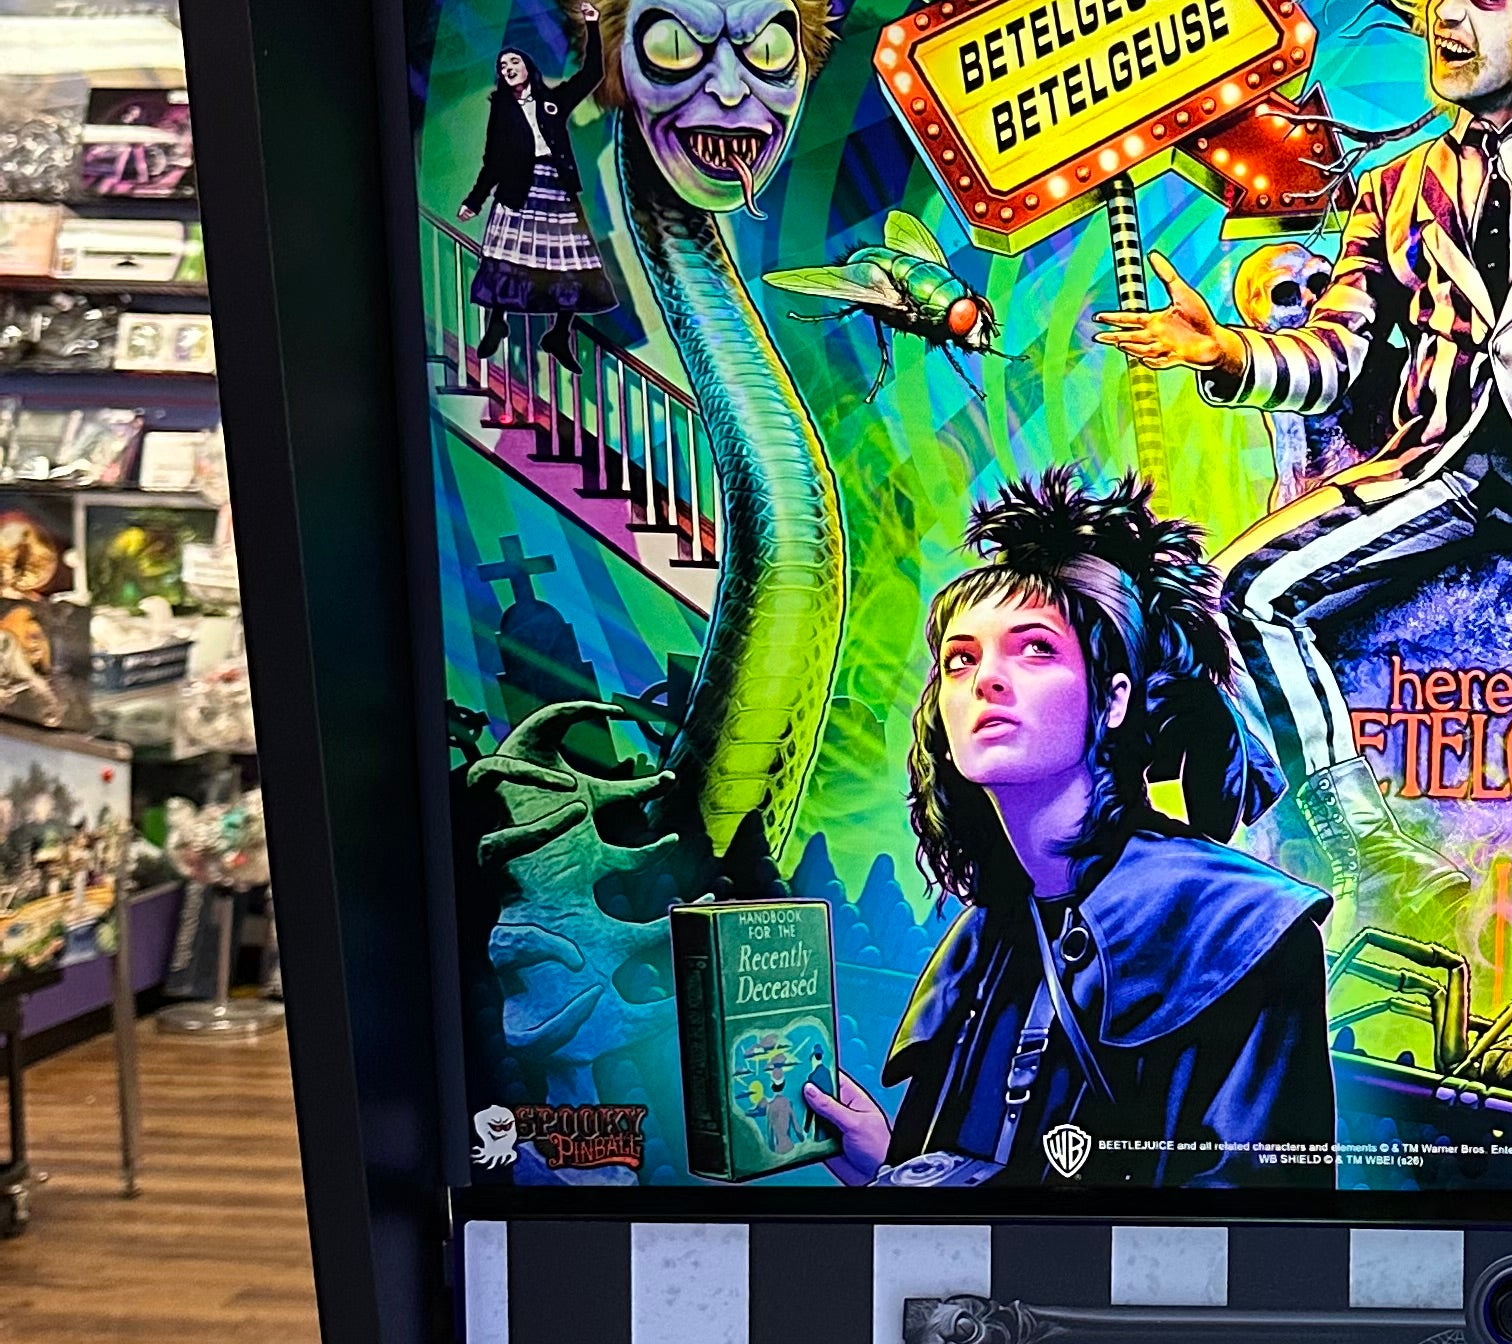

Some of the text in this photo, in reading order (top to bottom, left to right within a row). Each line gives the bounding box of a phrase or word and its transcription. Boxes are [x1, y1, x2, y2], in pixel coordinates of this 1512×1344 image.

[738, 910, 802, 925] HANDBOOK
[748, 924, 796, 940] FOR THE
[737, 940, 813, 978] Recently
[736, 968, 818, 1004] Deceased
[515, 1106, 647, 1140] SPOOKY
[548, 1132, 641, 1167] PINBALL
[1047, 1128, 1089, 1175] WB
[1098, 1140, 1174, 1151] BEETLEJUICE
[1177, 1141, 1197, 1151] and
[1199, 1141, 1212, 1151] all
[1214, 1141, 1250, 1152] related
[1252, 1142, 1306, 1152] characters
[1308, 1142, 1329, 1153] and
[1331, 1143, 1377, 1153] elements
[1402, 1144, 1419, 1154] TM
[1421, 1144, 1458, 1155] Warner
[1259, 1154, 1278, 1164] WB
[1280, 1154, 1322, 1164] SHIELD
[1347, 1155, 1363, 1165] TM
